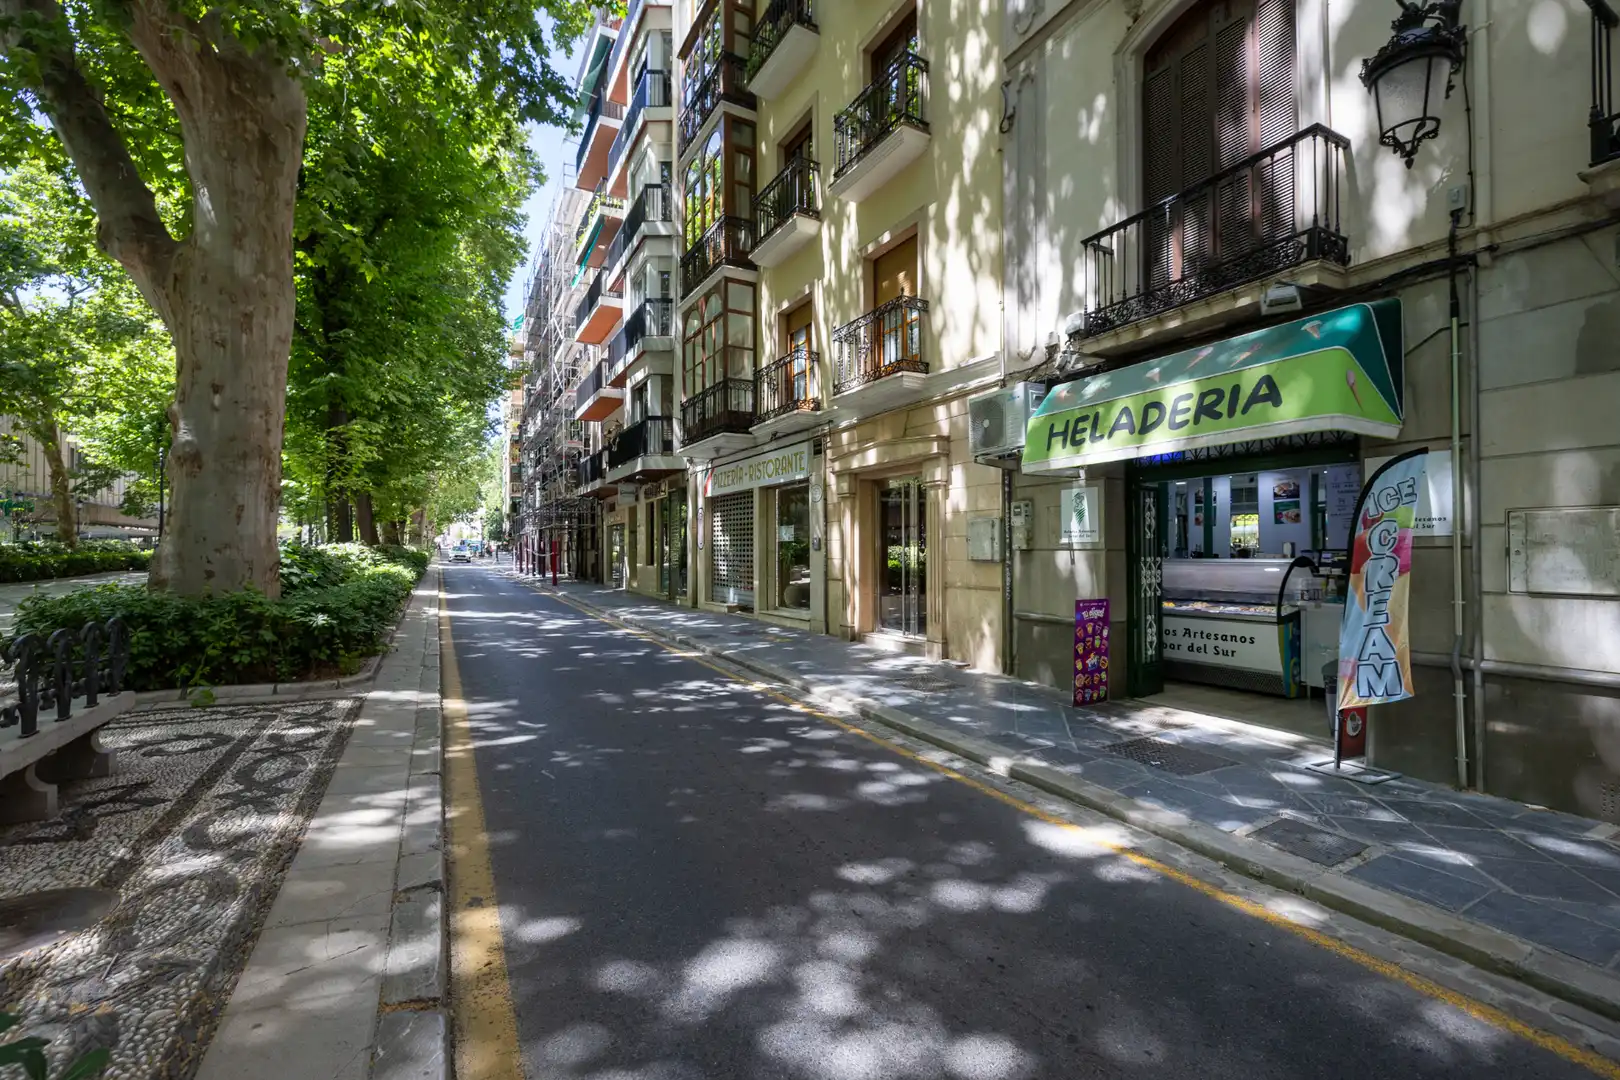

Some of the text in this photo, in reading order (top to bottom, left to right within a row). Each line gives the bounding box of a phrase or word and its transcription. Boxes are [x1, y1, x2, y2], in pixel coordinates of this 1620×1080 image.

[1046, 374, 1282, 452] HELADERIA
[748, 451, 805, 482] RISTORANTE
[1366, 476, 1417, 518] ICE
[1356, 519, 1403, 698] CREAM
[1182, 627, 1256, 645] Artesanos
[1187, 642, 1208, 655] del
[1213, 645, 1237, 658] Sur
